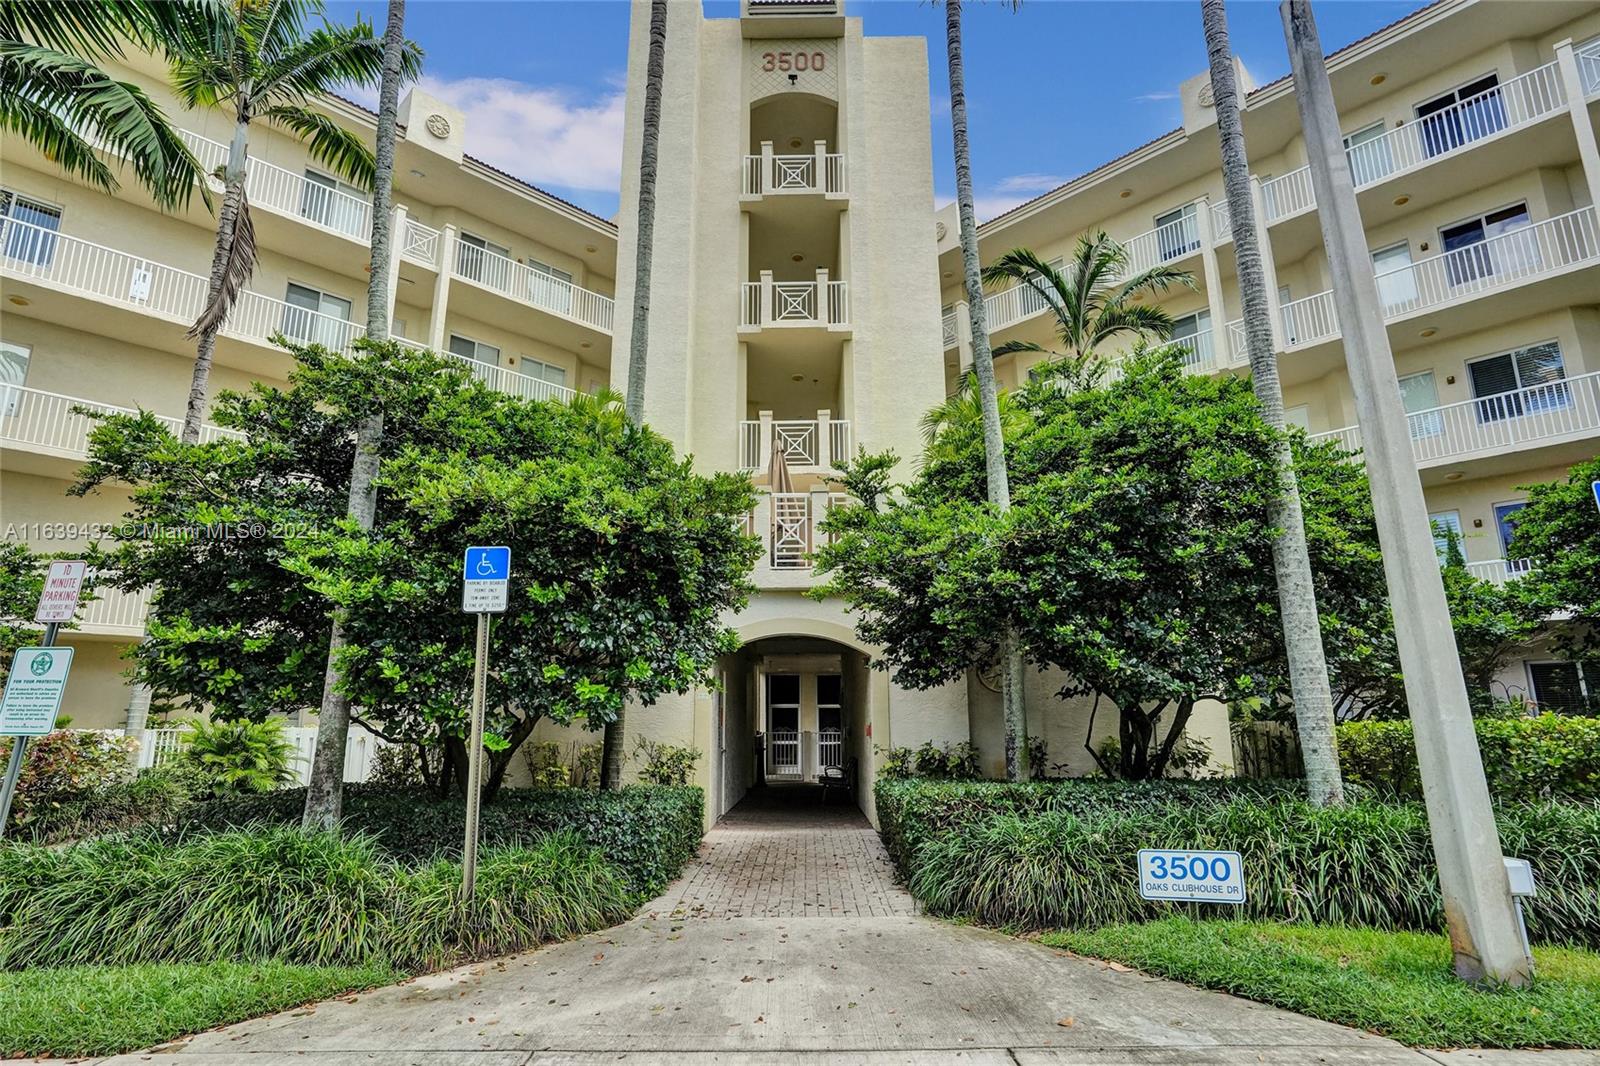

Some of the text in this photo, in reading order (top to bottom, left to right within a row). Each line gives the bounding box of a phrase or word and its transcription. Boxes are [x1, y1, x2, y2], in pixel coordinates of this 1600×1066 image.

[762, 52, 825, 72] 3500
[63, 564, 73, 576] 10
[50, 578, 77, 588] MINUTE
[44, 591, 76, 601] PARKING
[1150, 856, 1231, 882] 3500
[1145, 882, 1239, 894] OAKS CLUBHOUSE DR
